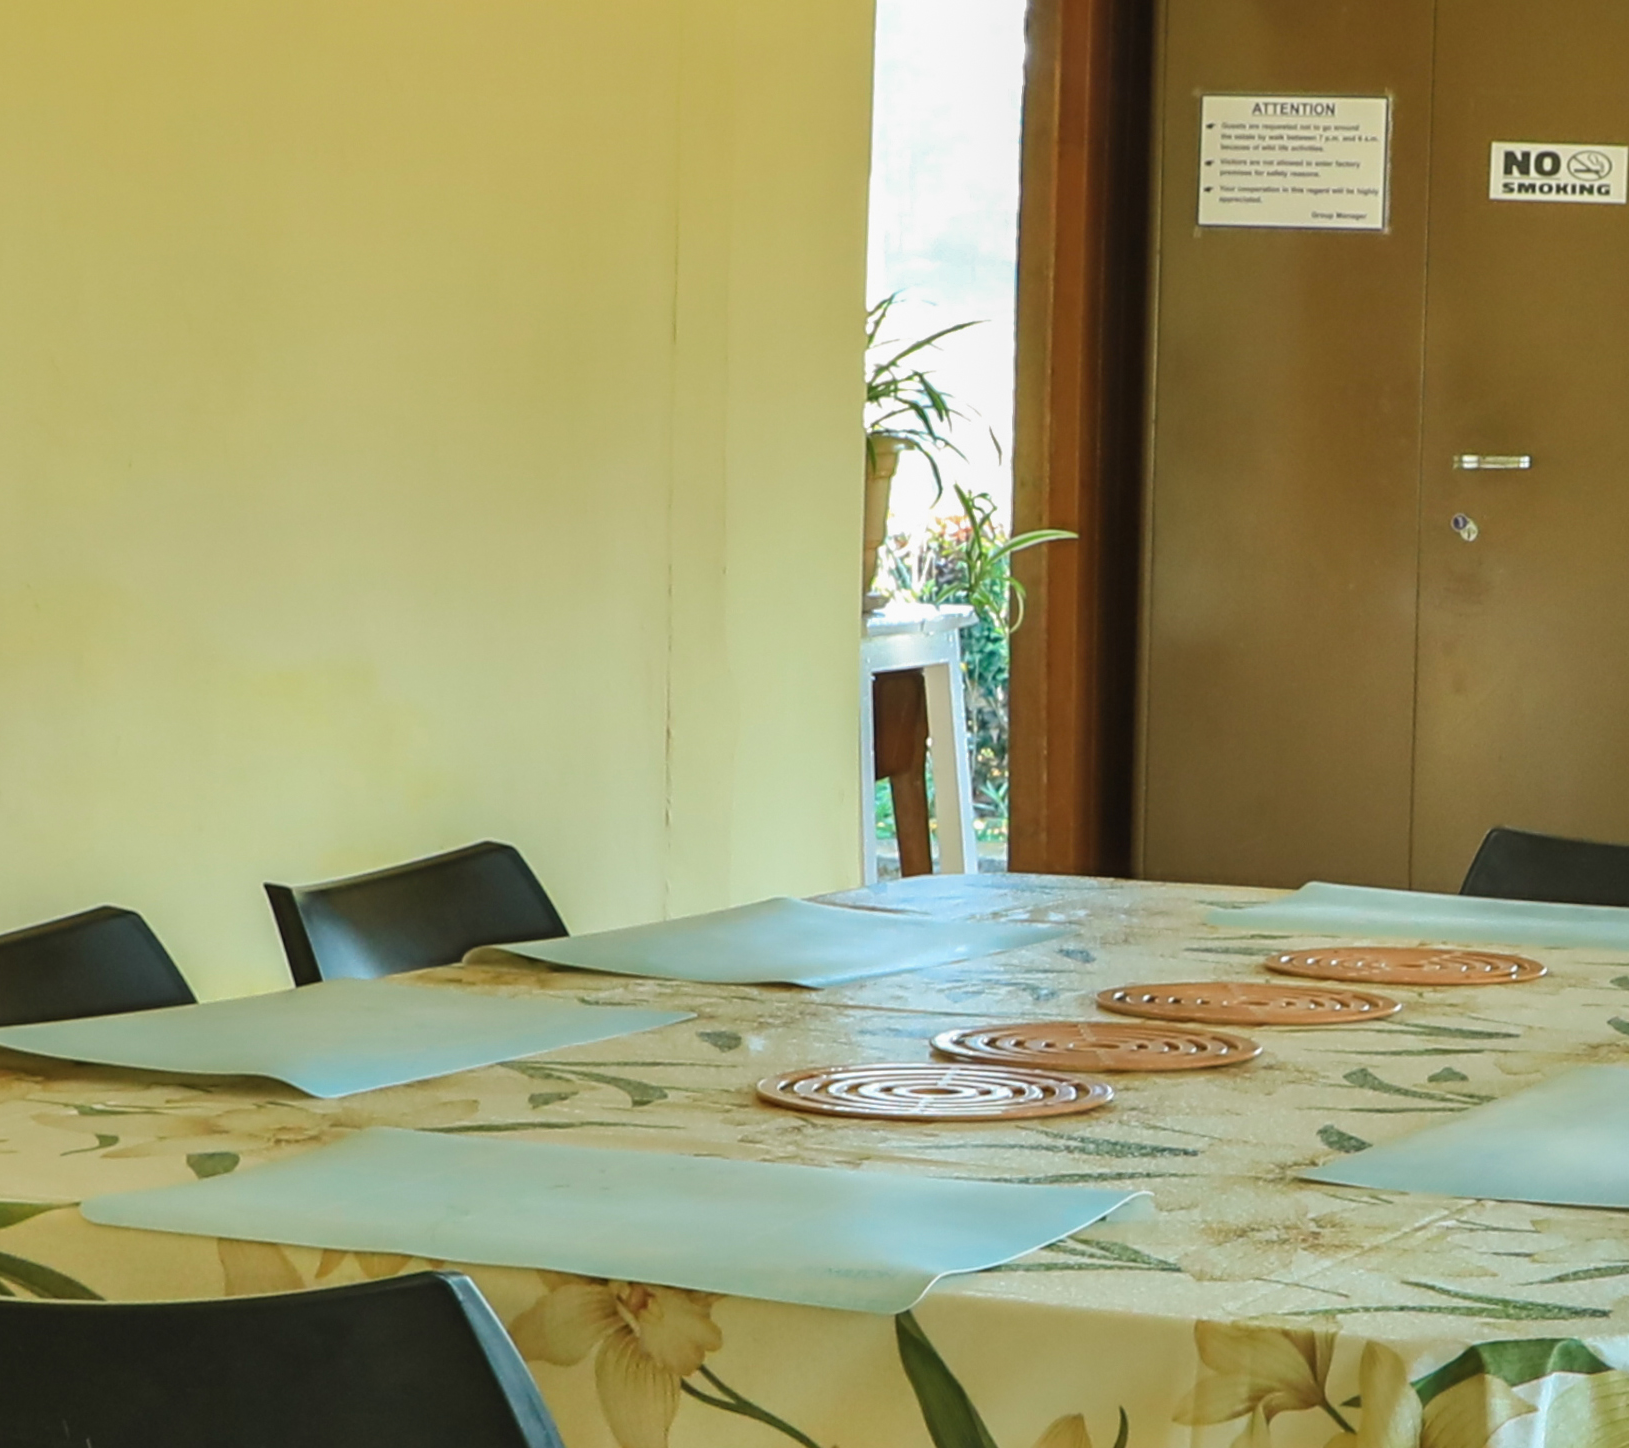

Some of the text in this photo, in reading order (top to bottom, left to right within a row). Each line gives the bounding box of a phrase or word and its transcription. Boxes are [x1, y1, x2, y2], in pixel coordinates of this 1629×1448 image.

[1252, 103, 1335, 115] ATTENTION
[1262, 124, 1297, 132] requested
[1504, 151, 1561, 176] NO
[1357, 188, 1378, 196] highly
[1502, 182, 1610, 195] SMOKING
[1311, 212, 1333, 220] Group
